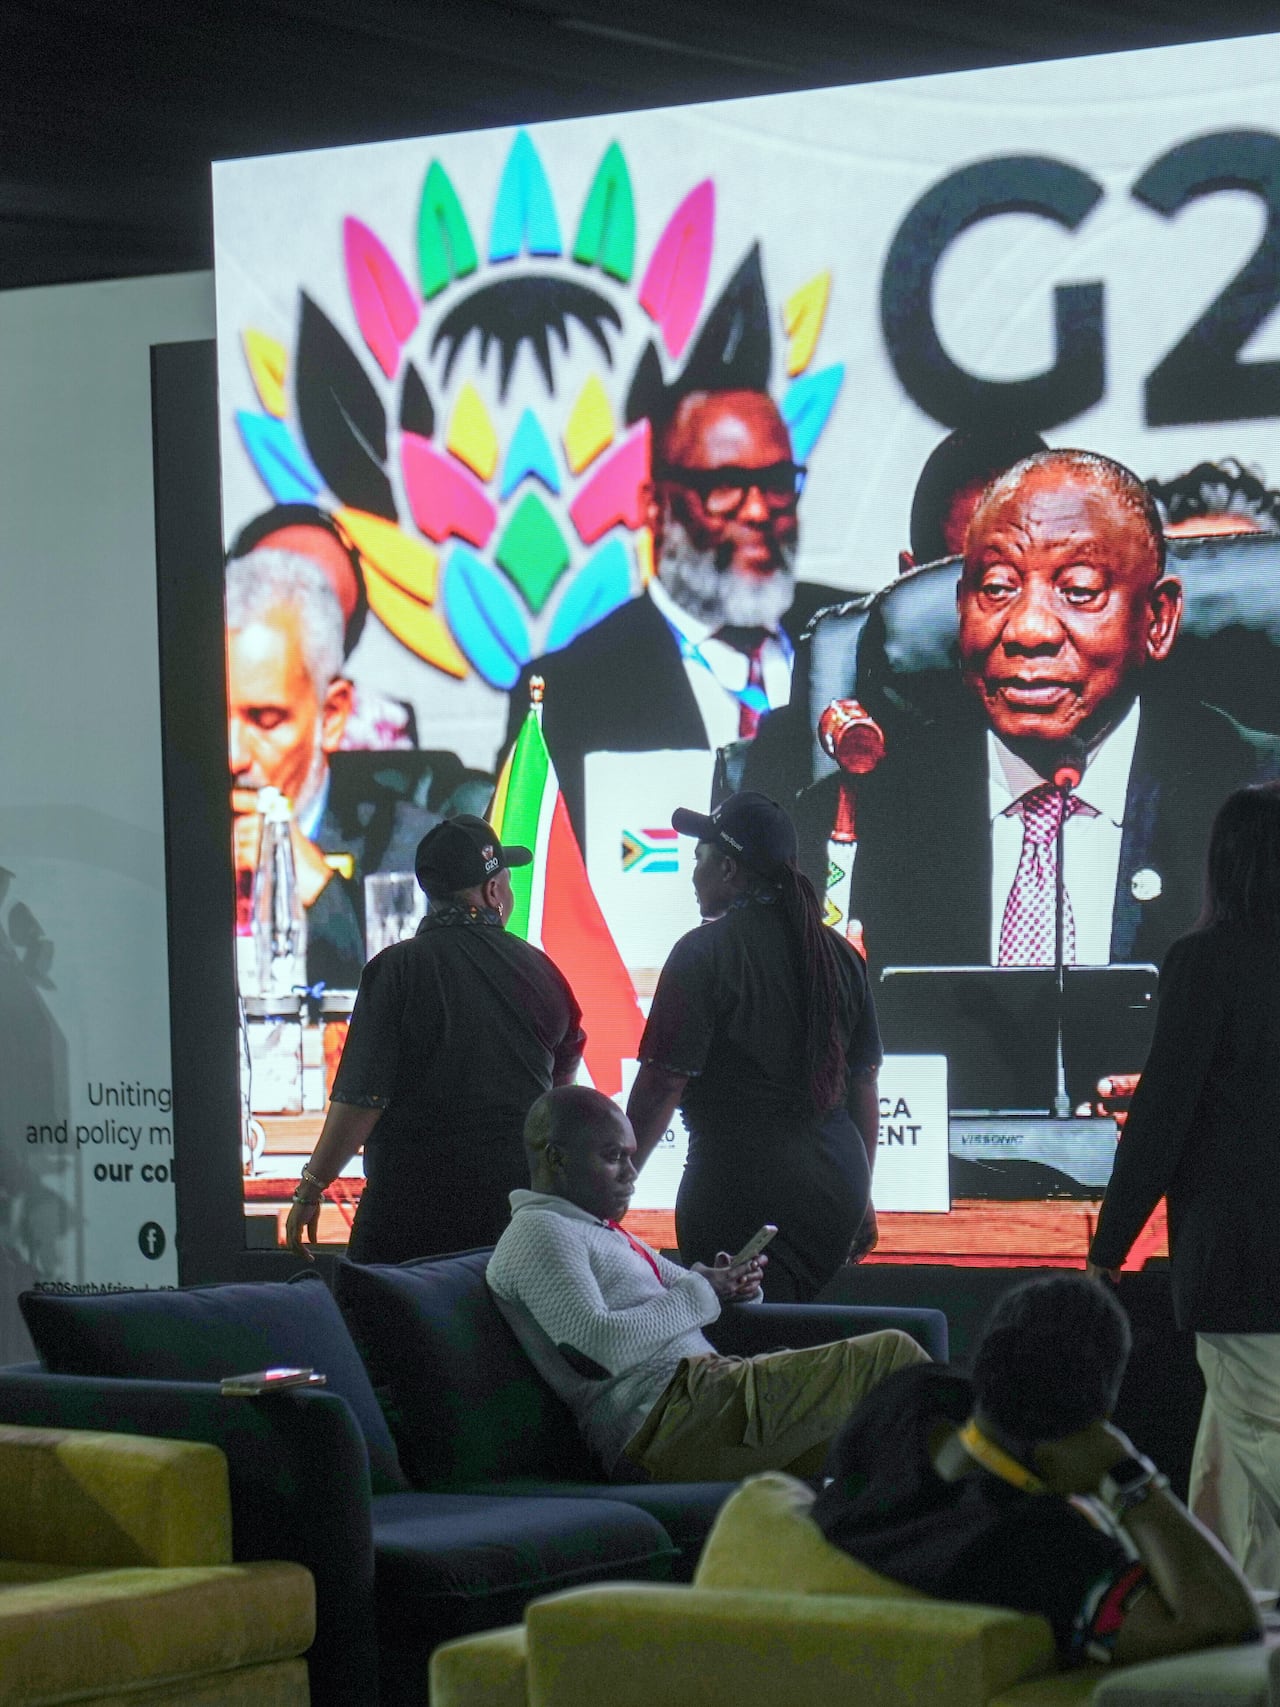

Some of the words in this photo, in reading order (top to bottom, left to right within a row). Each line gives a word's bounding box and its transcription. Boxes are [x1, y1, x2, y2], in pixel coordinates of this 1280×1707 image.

[485, 857, 499, 871] G20
[88, 1081, 172, 1113] Uniting
[26, 1119, 68, 1144] and
[76, 1118, 142, 1151] policy
[149, 1126, 172, 1145] m
[94, 1163, 134, 1182] our
